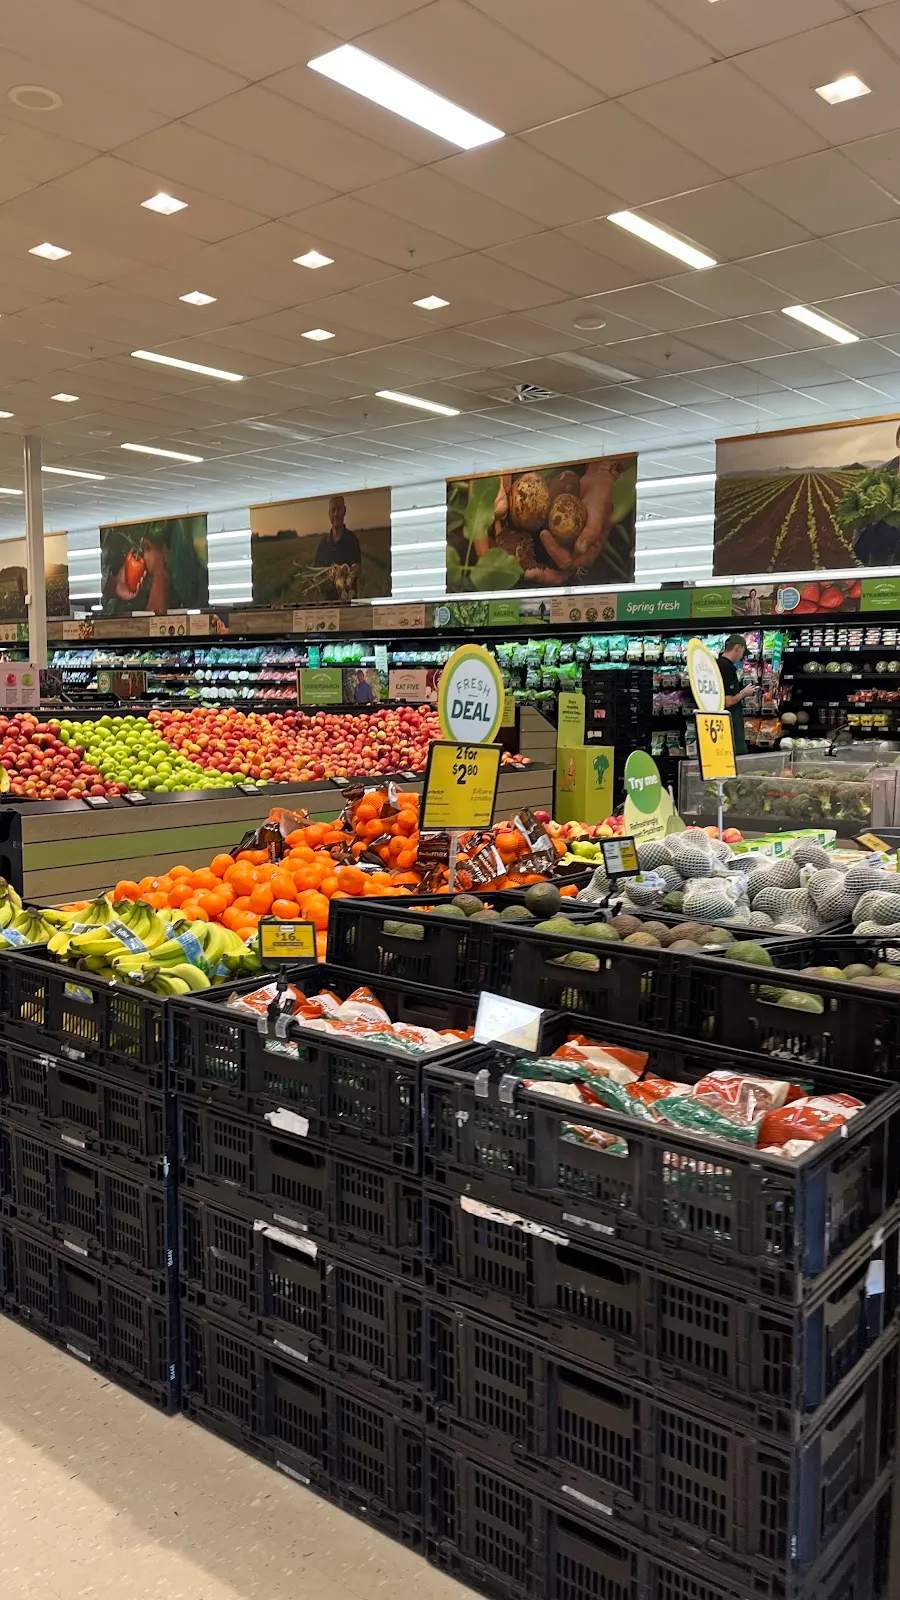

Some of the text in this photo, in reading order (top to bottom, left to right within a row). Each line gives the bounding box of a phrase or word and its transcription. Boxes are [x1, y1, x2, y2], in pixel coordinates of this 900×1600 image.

[626, 600, 681, 615] Spring fresh
[456, 678, 491, 697] FRESH
[697, 679, 719, 695] DEAL
[451, 699, 491, 722] DEAL
[455, 746, 478, 760] 2 for
[628, 775, 659, 792] Try me
